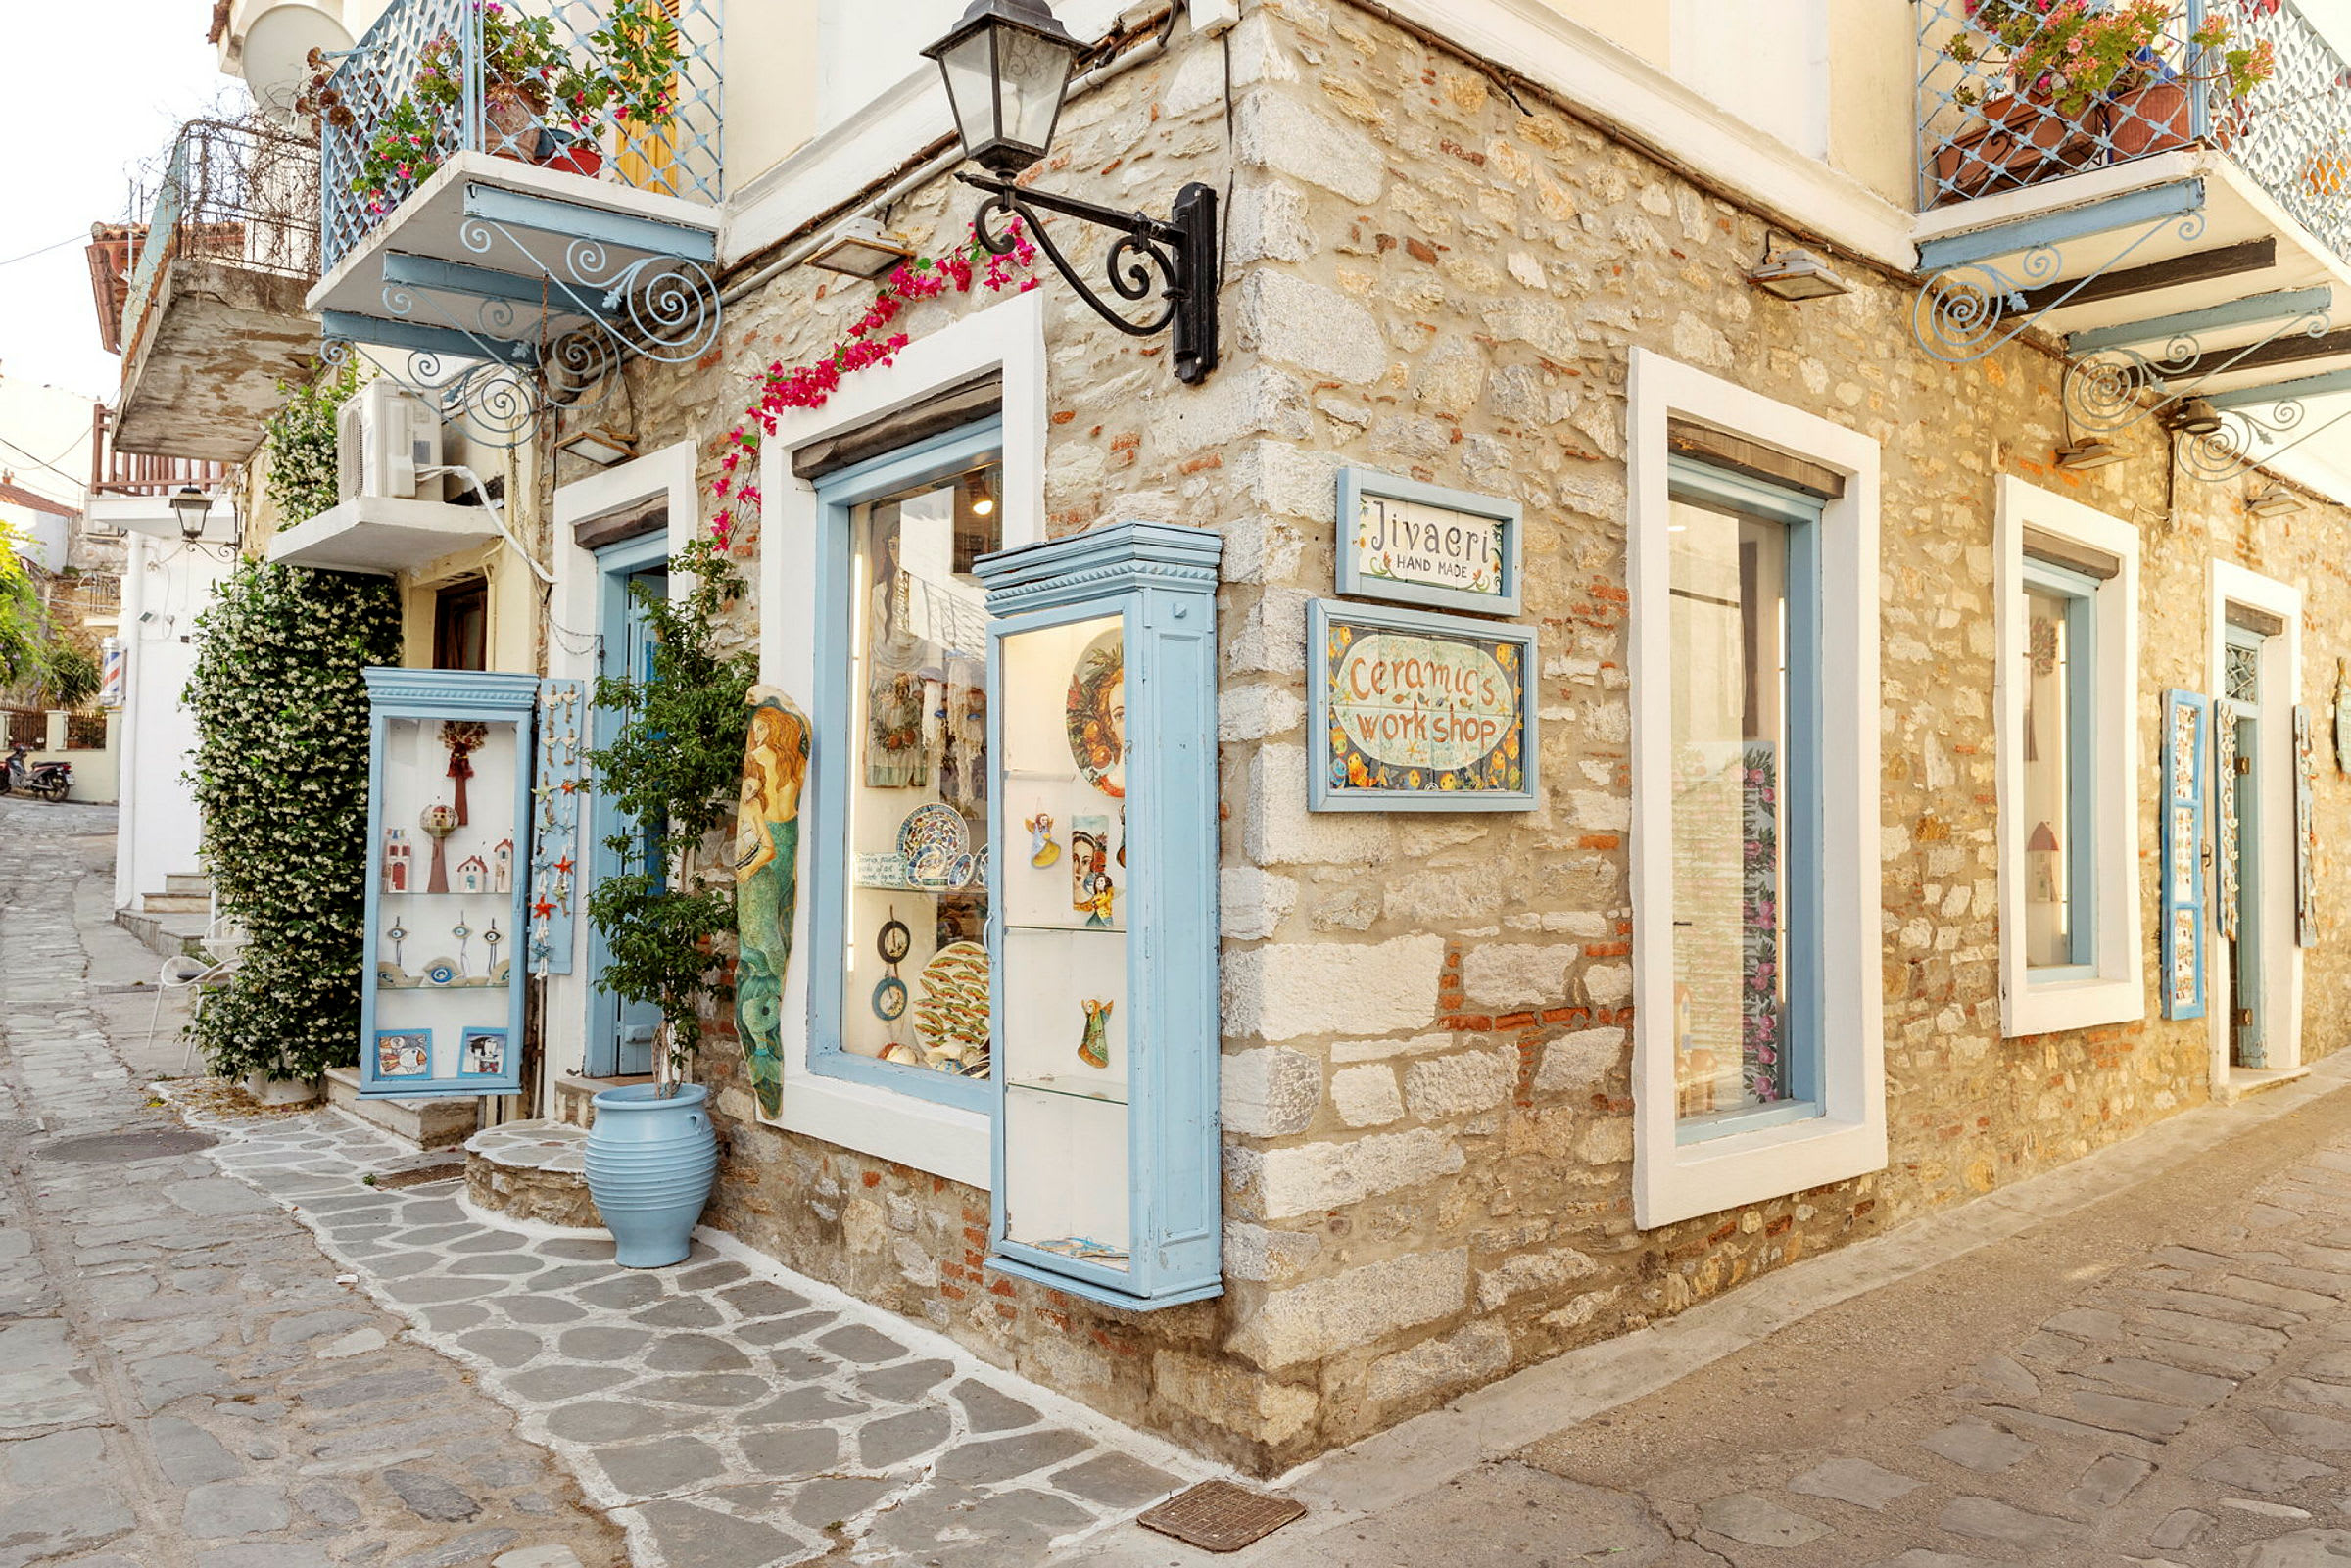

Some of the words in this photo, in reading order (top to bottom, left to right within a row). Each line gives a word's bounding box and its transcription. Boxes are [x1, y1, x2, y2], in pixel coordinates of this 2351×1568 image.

[1371, 500, 1488, 563] Jivaeri
[1397, 554, 1431, 571] HAND
[1438, 561, 1467, 578] MADE
[1350, 658, 1495, 706] Ceramics
